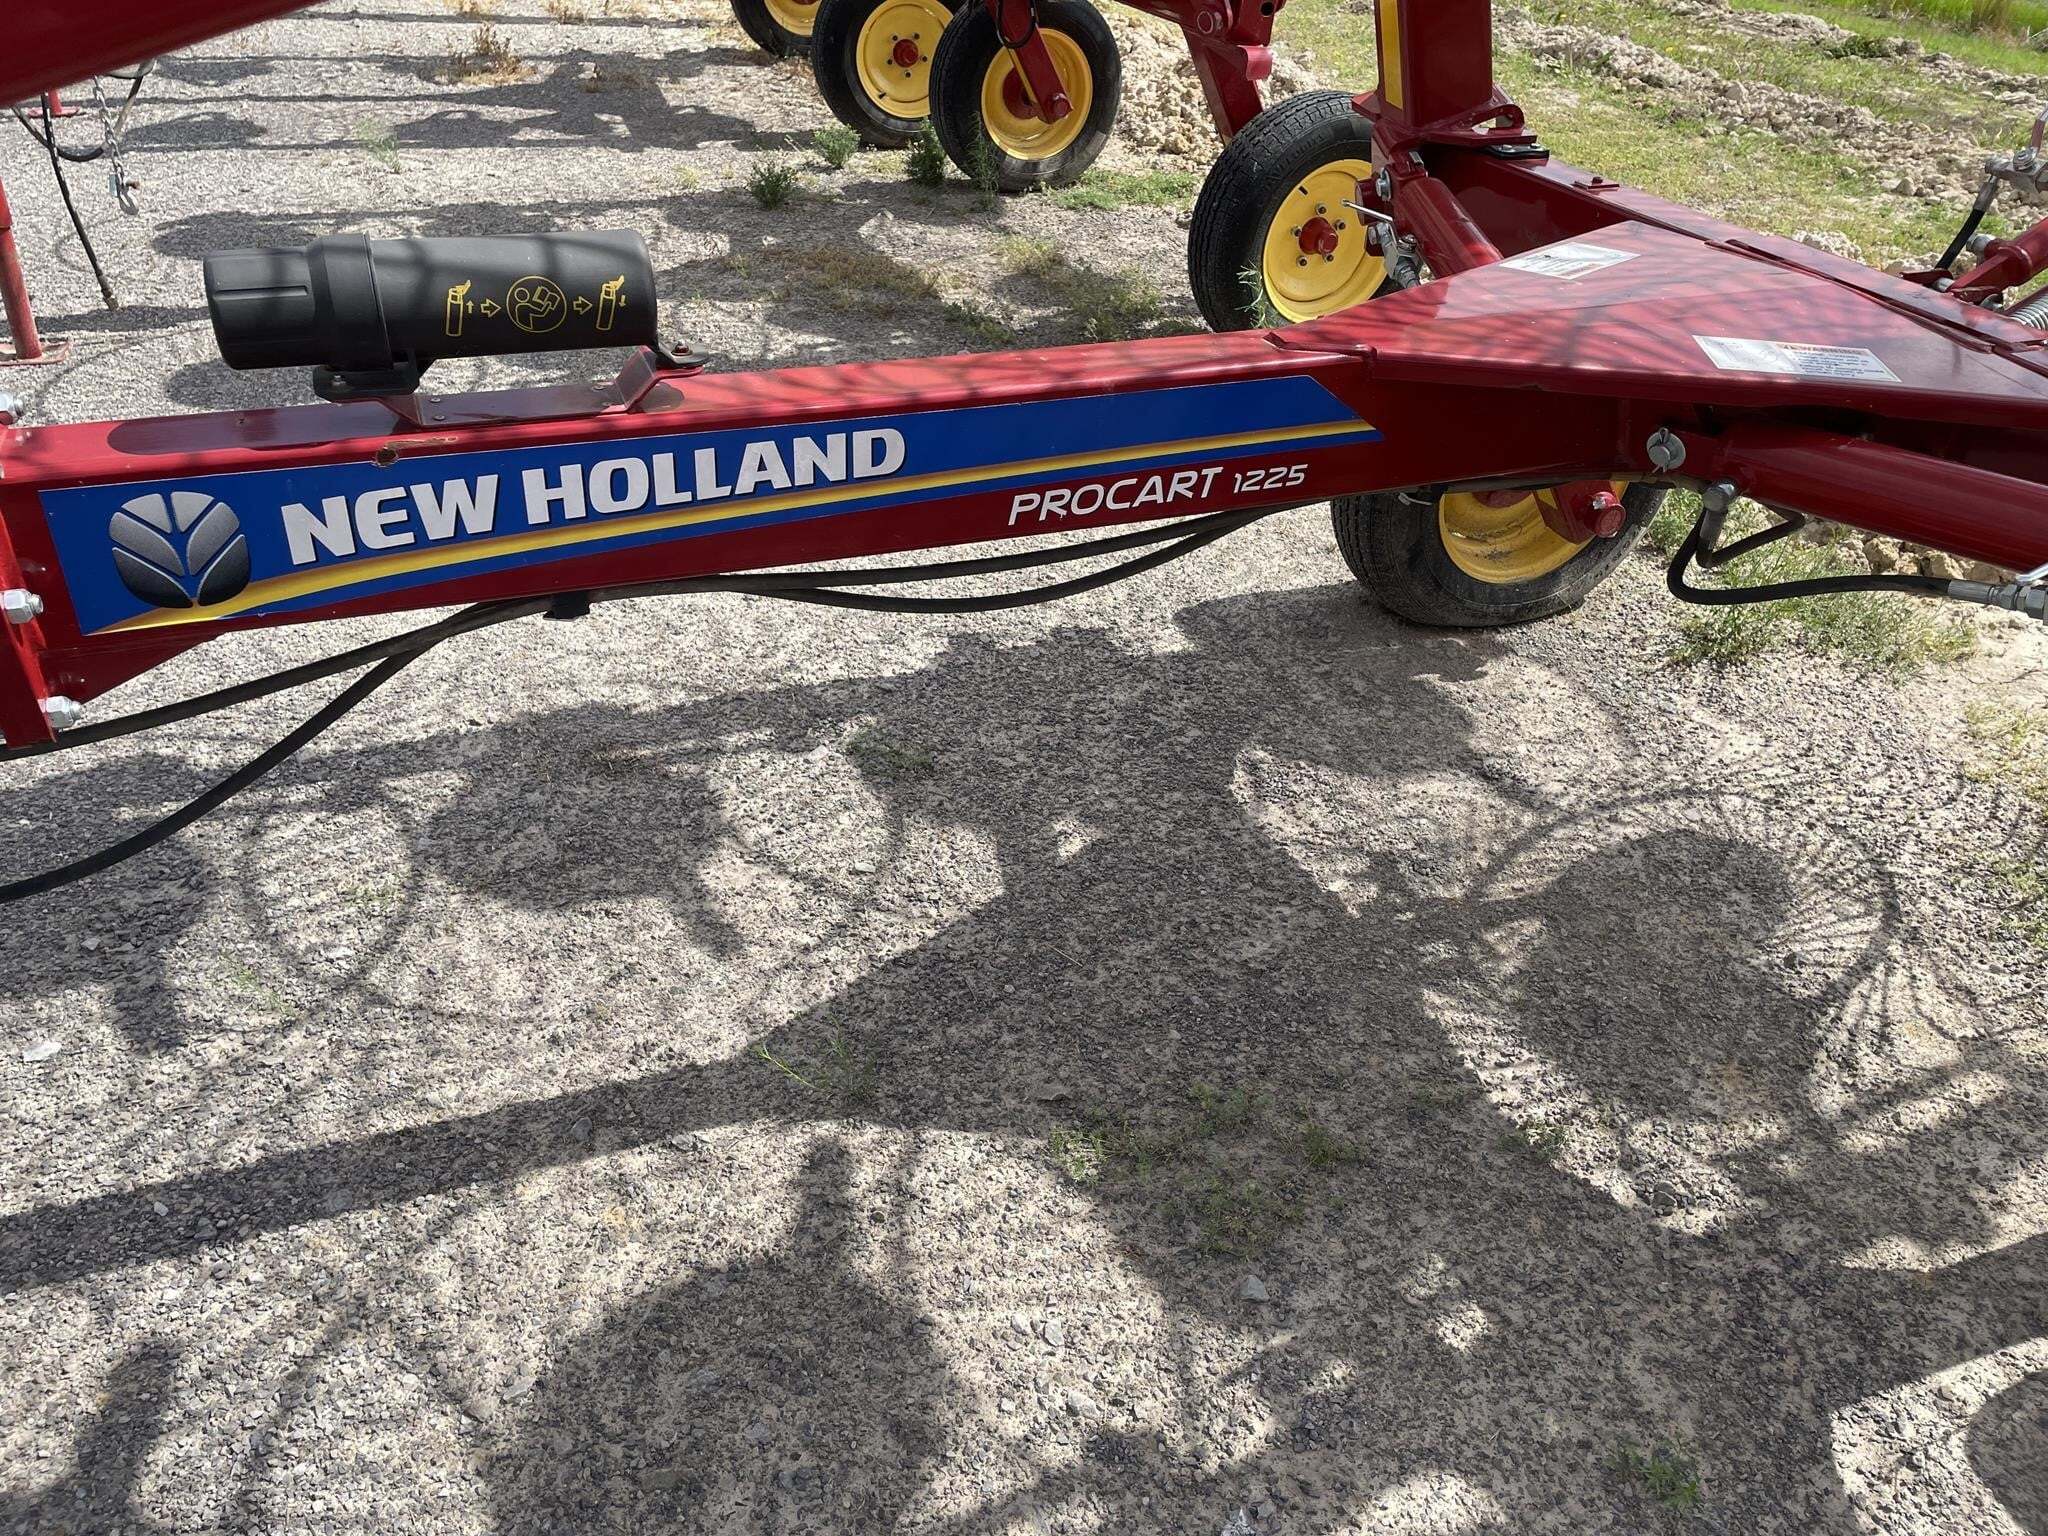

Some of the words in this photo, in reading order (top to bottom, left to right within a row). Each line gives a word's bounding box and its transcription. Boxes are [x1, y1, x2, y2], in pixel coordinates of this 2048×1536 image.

[281, 474, 499, 566] NEW
[522, 428, 907, 526] HOLLAND
[1008, 467, 1223, 526] PROCART
[1233, 464, 1308, 494] 1225
